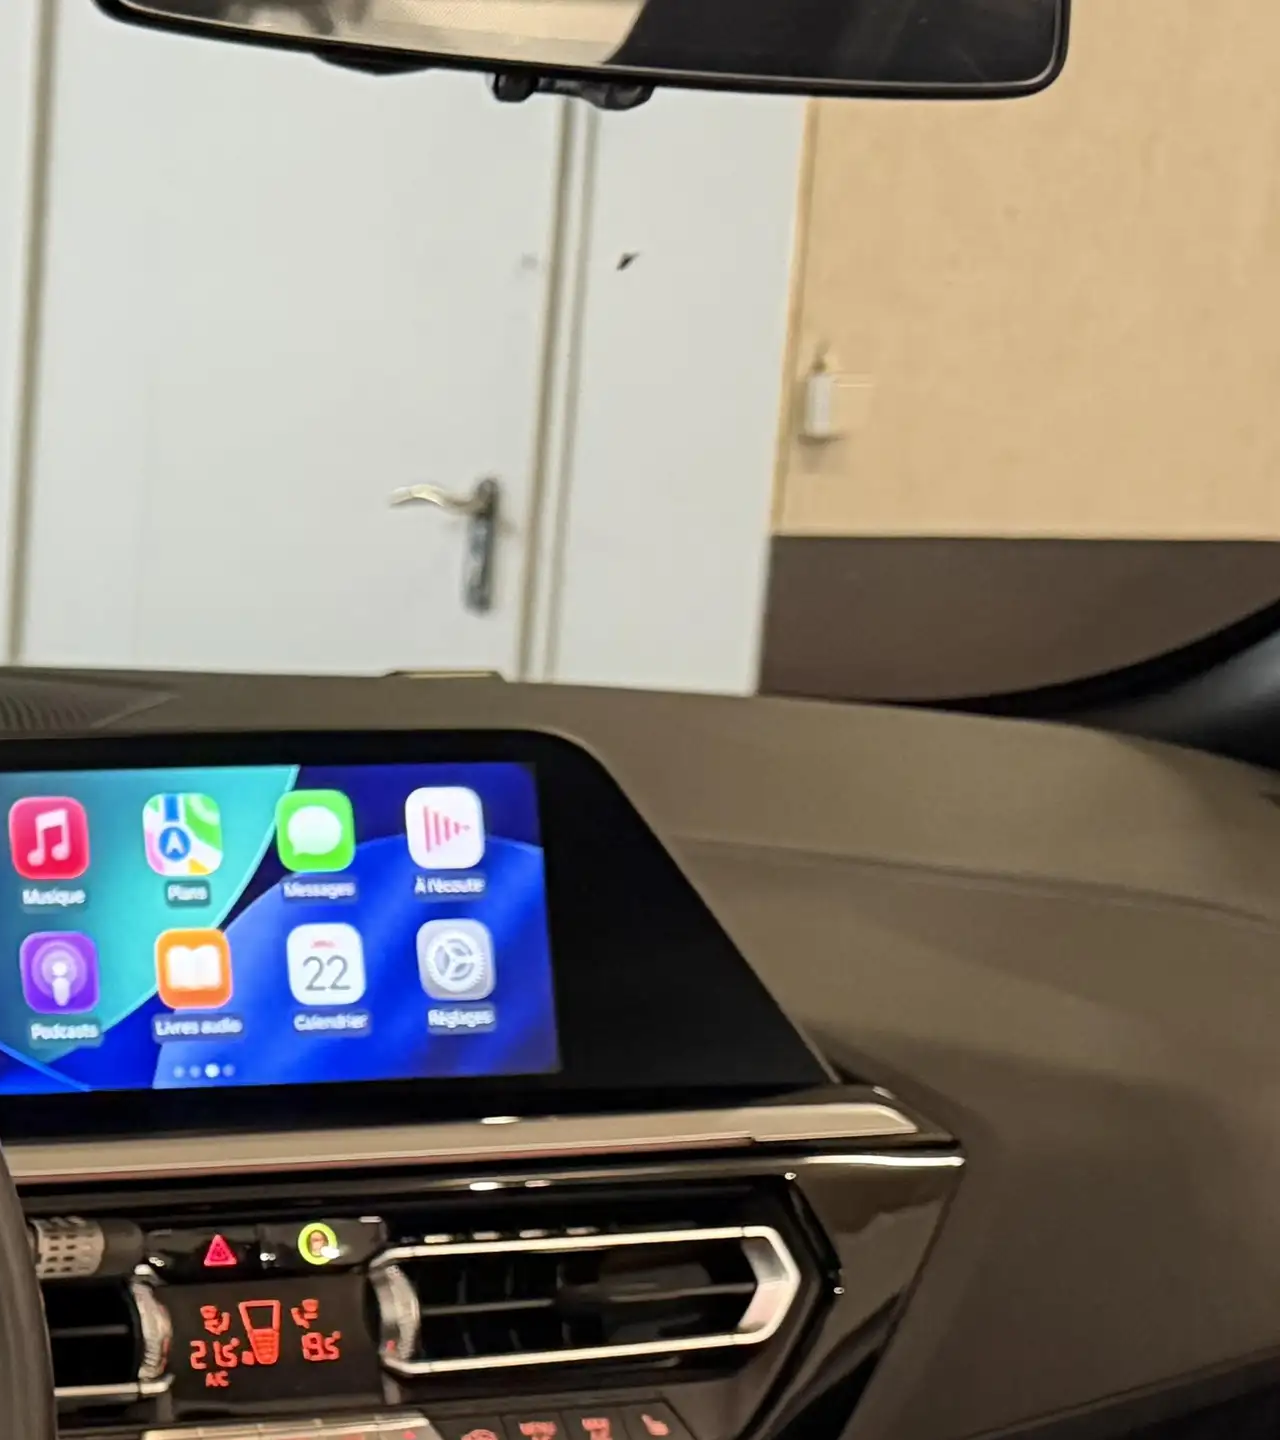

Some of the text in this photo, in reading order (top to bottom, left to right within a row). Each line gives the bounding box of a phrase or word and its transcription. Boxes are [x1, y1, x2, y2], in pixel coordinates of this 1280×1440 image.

[22, 889, 86, 906] Musique
[167, 884, 208, 901] Plans
[283, 881, 356, 899] Messages
[302, 955, 351, 992] 22
[293, 1013, 369, 1032] Calendrier
[31, 1023, 98, 1040] Podcasts
